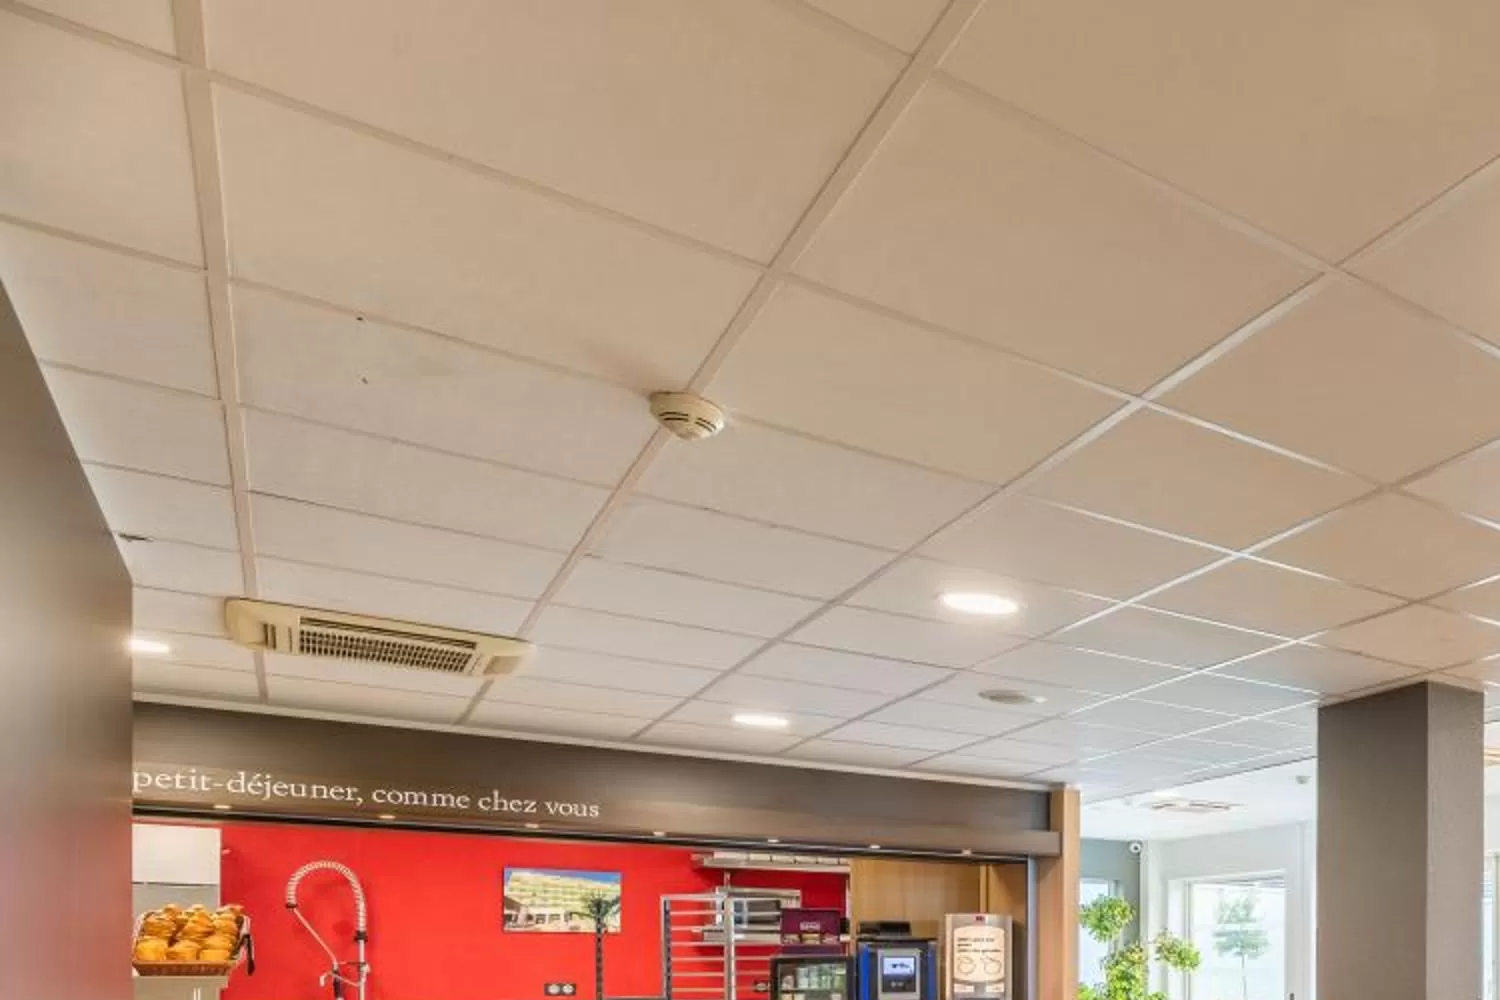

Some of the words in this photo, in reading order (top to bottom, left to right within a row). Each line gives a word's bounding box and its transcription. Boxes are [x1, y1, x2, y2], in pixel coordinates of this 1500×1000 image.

[132, 768, 364, 805] petit-déjeuner,
[371, 788, 470, 809] comme
[477, 789, 537, 812] chez
[546, 801, 600, 818] vous
